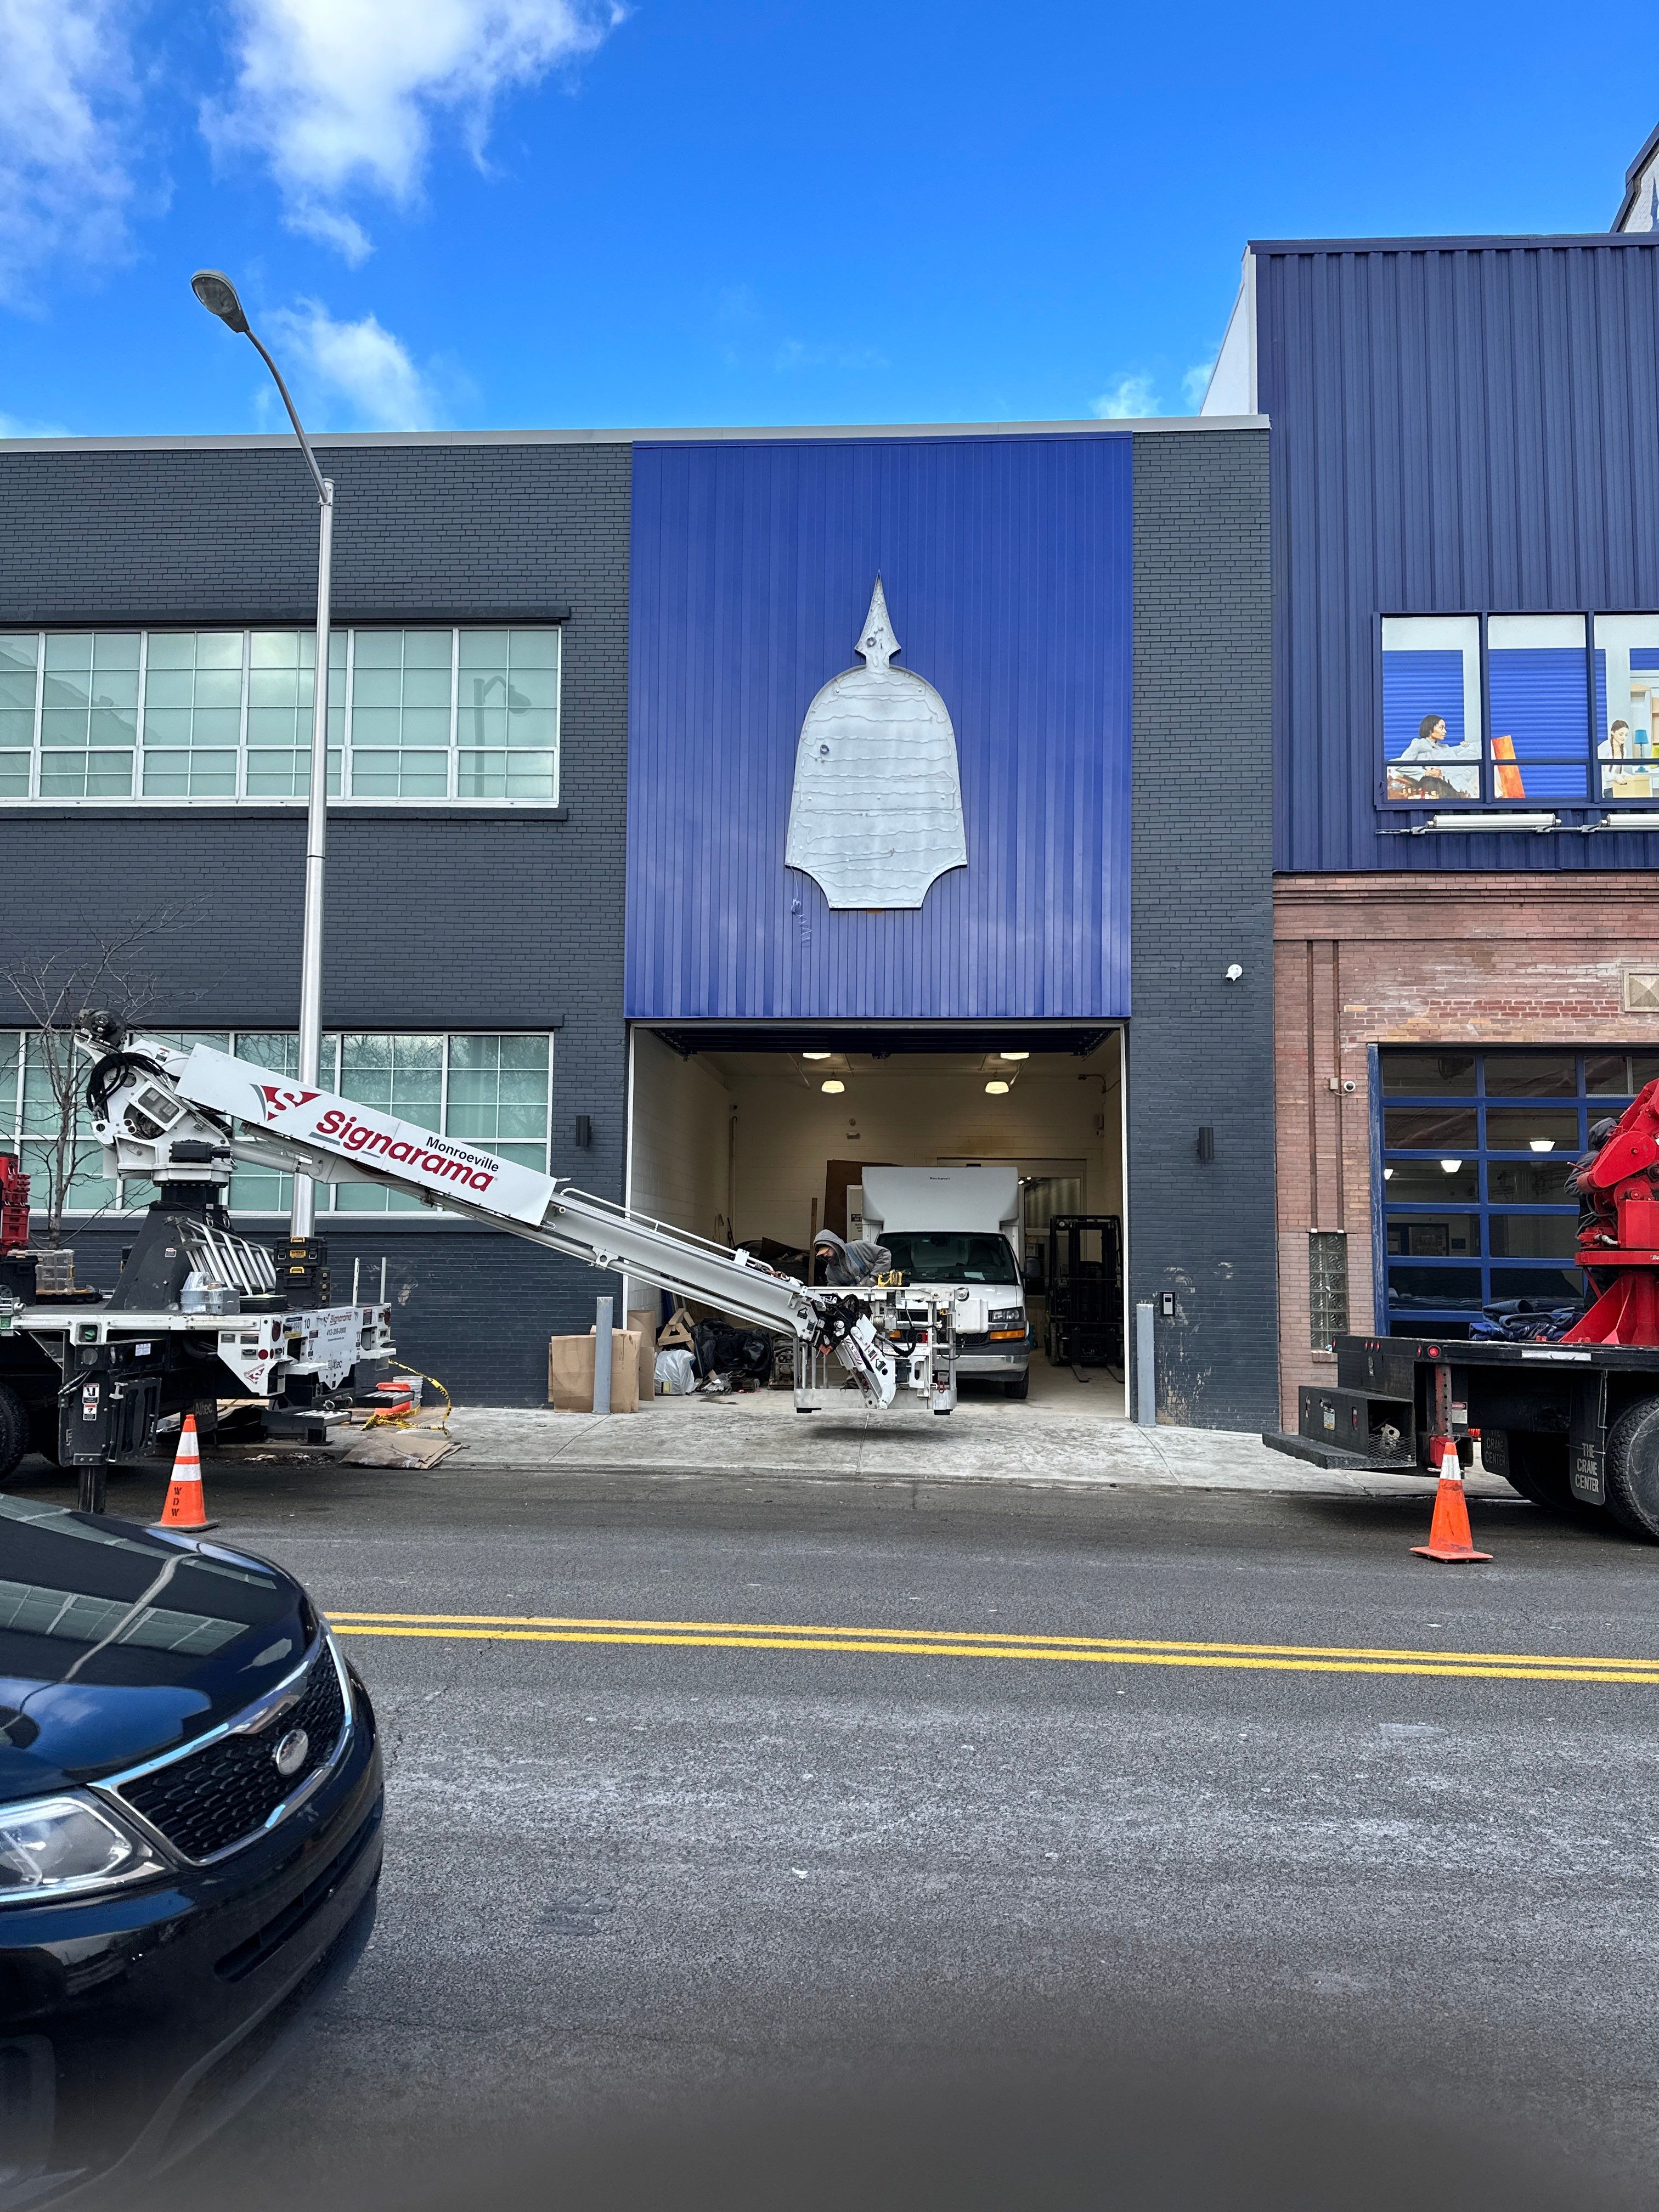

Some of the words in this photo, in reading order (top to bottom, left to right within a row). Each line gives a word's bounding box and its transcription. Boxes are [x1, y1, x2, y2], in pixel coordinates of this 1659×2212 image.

[316, 1110, 494, 1192] Signarama
[426, 1136, 499, 1172] Monroeville
[304, 1318, 311, 1329] 10
[195, 1401, 213, 1415] Altec
[1486, 1437, 1505, 1452] CRANE
[1582, 1443, 1595, 1459] THE
[1485, 1451, 1506, 1466] CENTER
[1577, 1458, 1598, 1476] CRANE
[1575, 1474, 1599, 1493] CENTER
